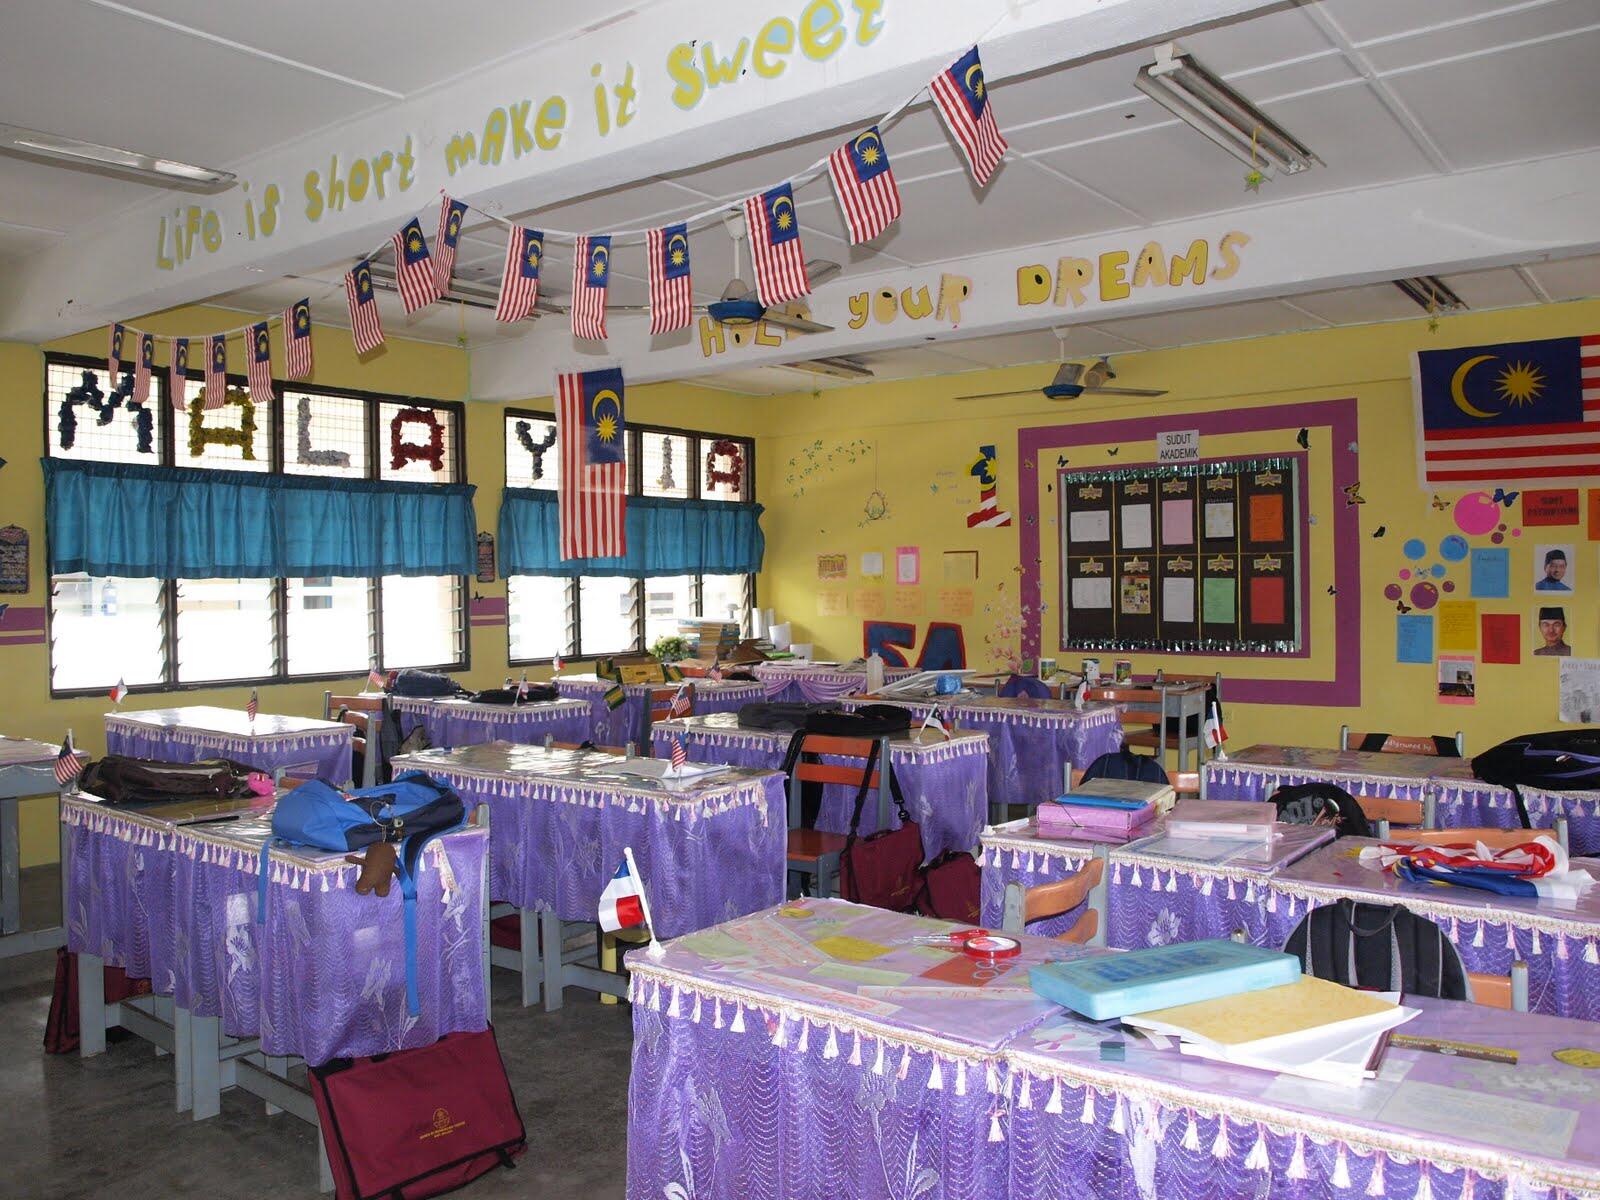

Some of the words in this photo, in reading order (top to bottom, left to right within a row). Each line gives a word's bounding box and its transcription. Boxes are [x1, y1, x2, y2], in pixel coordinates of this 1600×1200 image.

[242, 180, 281, 241] is
[590, 61, 637, 138] it
[1016, 230, 1252, 308] DREAMS
[1160, 447, 1199, 460] AKADEMIK
[1166, 433, 1192, 446] SUDUT
